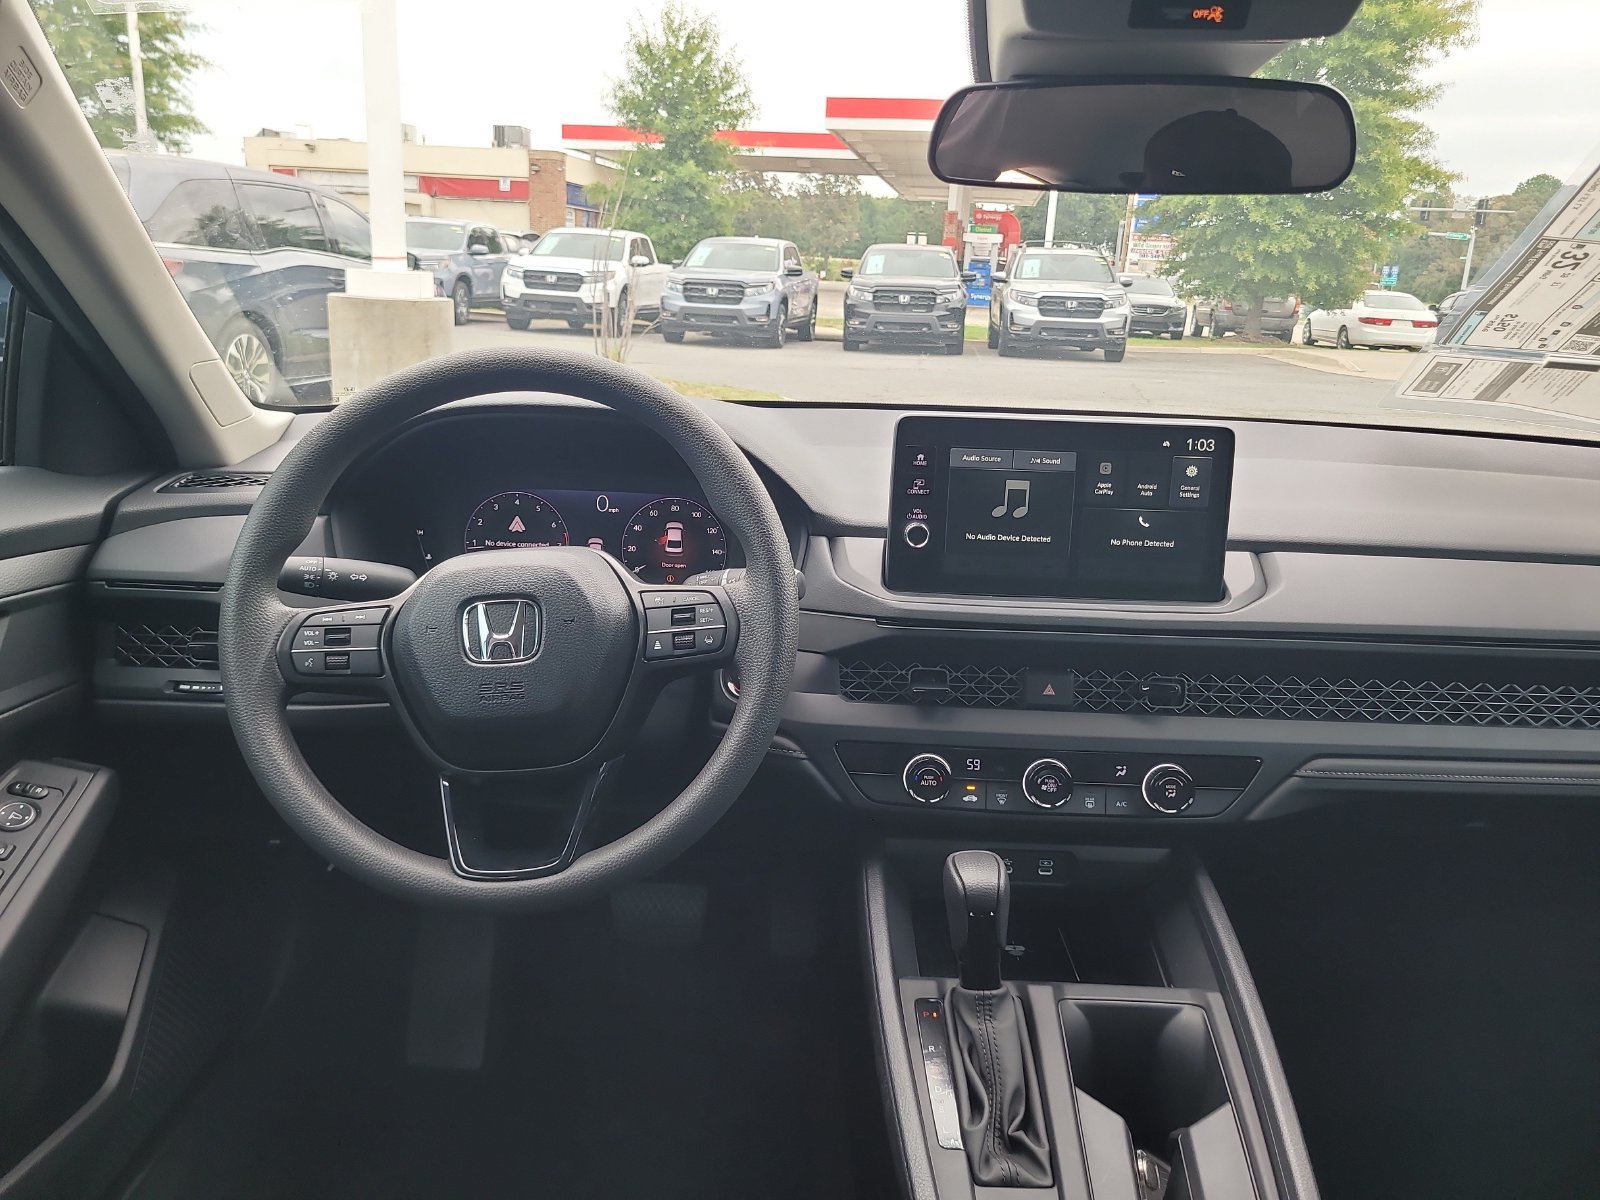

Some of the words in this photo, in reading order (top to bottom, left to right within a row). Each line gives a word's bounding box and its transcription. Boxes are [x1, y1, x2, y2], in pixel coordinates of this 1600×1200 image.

[10, 60, 32, 92] CURTAIN
[19, 59, 32, 80] SIDE
[4, 68, 26, 102] AIRBAG
[1186, 438, 1215, 452] 1:03
[596, 494, 609, 512] 0
[966, 759, 980, 771] 59
